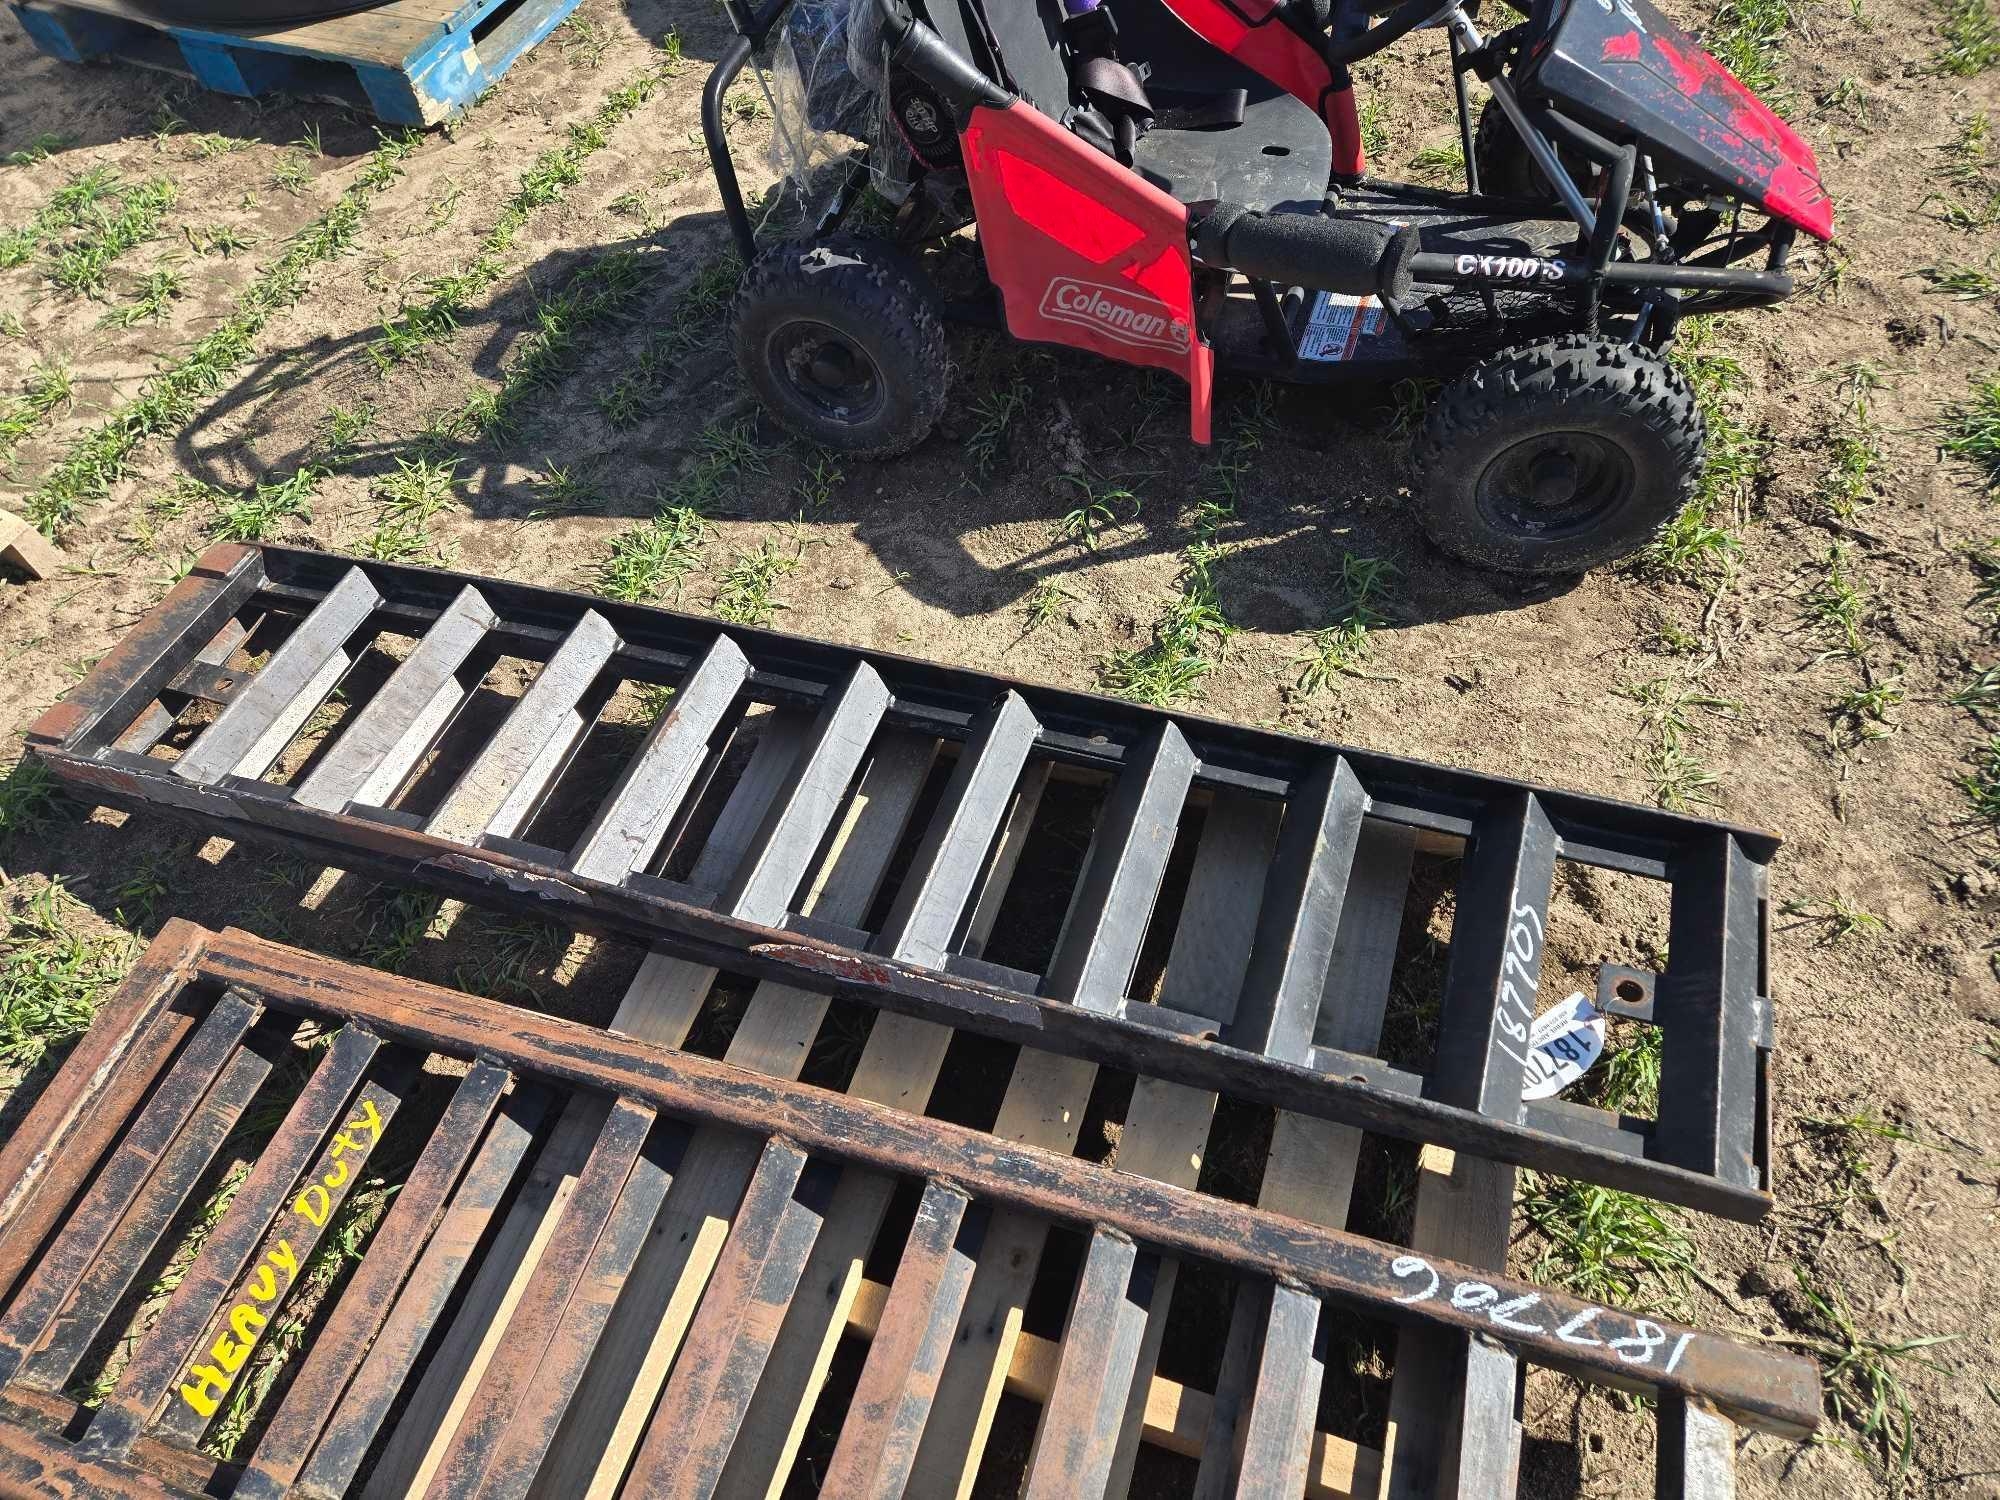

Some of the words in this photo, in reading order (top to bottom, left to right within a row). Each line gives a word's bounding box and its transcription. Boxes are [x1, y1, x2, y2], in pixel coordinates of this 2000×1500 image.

[923, 117, 938, 132] HP
[1055, 284, 1167, 337] Coleman
[1496, 887, 1544, 1067] 187705
[180, 1239, 298, 1417] HEAVY
[1391, 1255, 1696, 1375] 187706
